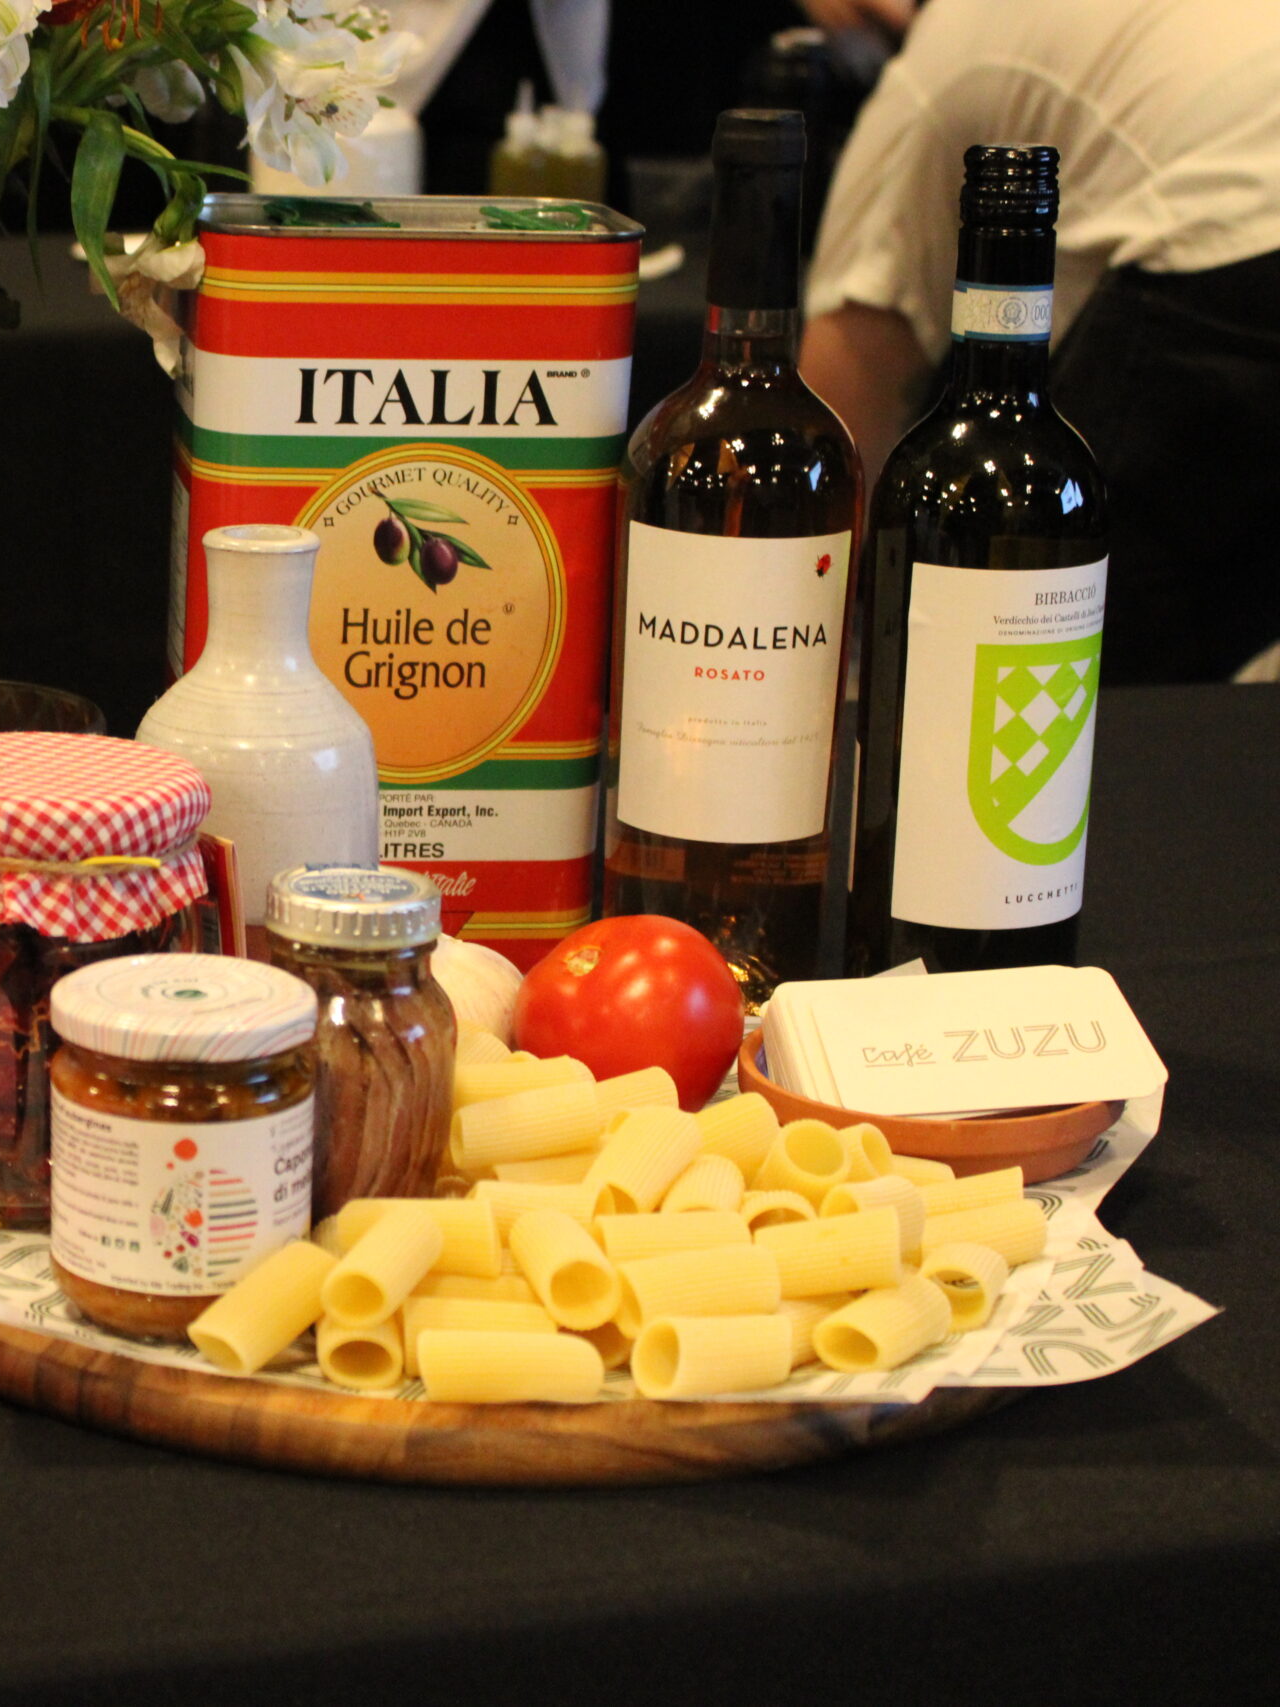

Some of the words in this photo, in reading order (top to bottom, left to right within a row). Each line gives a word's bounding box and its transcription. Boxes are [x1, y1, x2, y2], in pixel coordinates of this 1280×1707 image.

[546, 370, 578, 378] BRAND
[294, 367, 559, 427] ITALIA
[334, 466, 427, 516] GOURMET
[432, 467, 511, 515] QUALITY
[340, 607, 435, 646] Huile
[446, 607, 492, 646] de
[993, 615, 1039, 625] Verdicchio
[1040, 615, 1053, 623] dei
[638, 611, 829, 651] MADDALENA
[343, 650, 487, 701] Grignon
[694, 666, 766, 682] ROSATO
[383, 805, 423, 819] Import
[427, 805, 471, 819] Export,
[475, 805, 499, 817] Inc.
[384, 829, 406, 838] H1P
[430, 819, 473, 828] CANADA
[380, 842, 445, 859] ITRES
[1005, 882, 1079, 905] LUCCHETTI
[943, 1020, 1107, 1063] ZUZU
